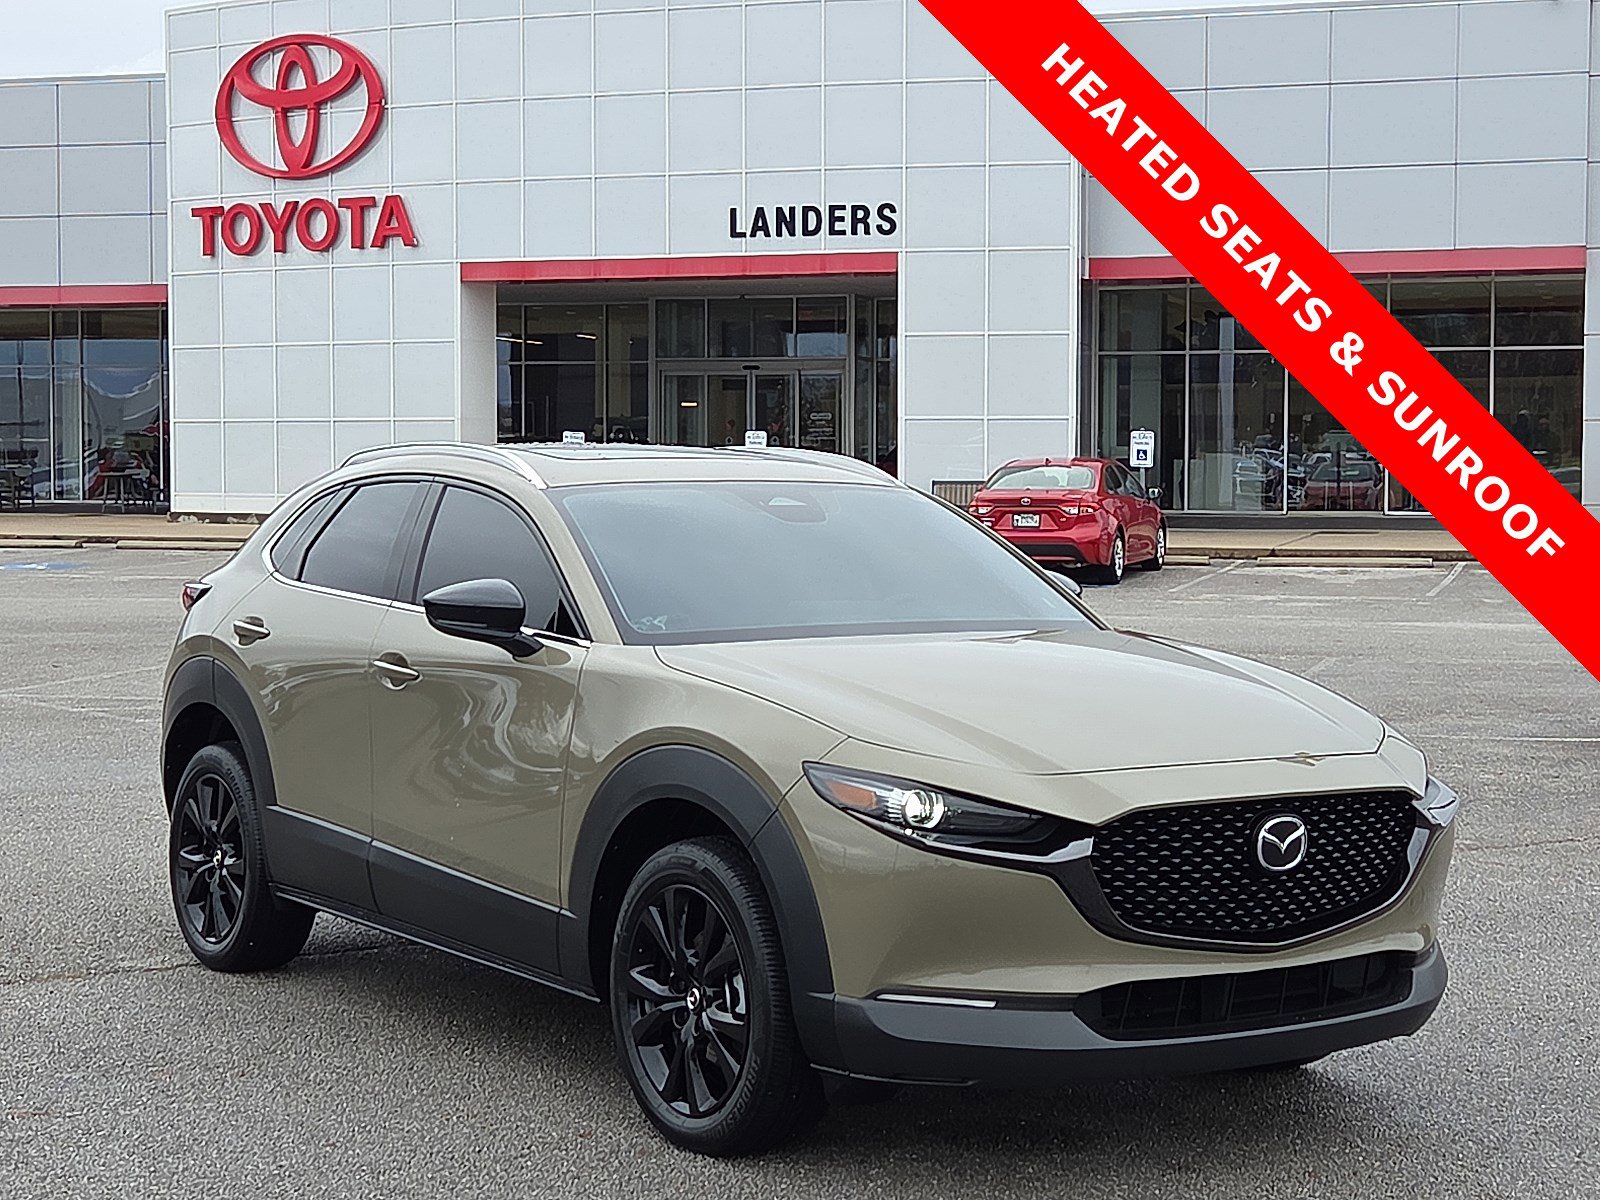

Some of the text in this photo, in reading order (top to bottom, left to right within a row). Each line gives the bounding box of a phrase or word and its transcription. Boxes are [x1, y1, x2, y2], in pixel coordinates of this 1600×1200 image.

[190, 194, 420, 257] TOYOTA
[729, 202, 897, 239] LANDERS
[704, 1051, 761, 1140] BRIDGESTO
